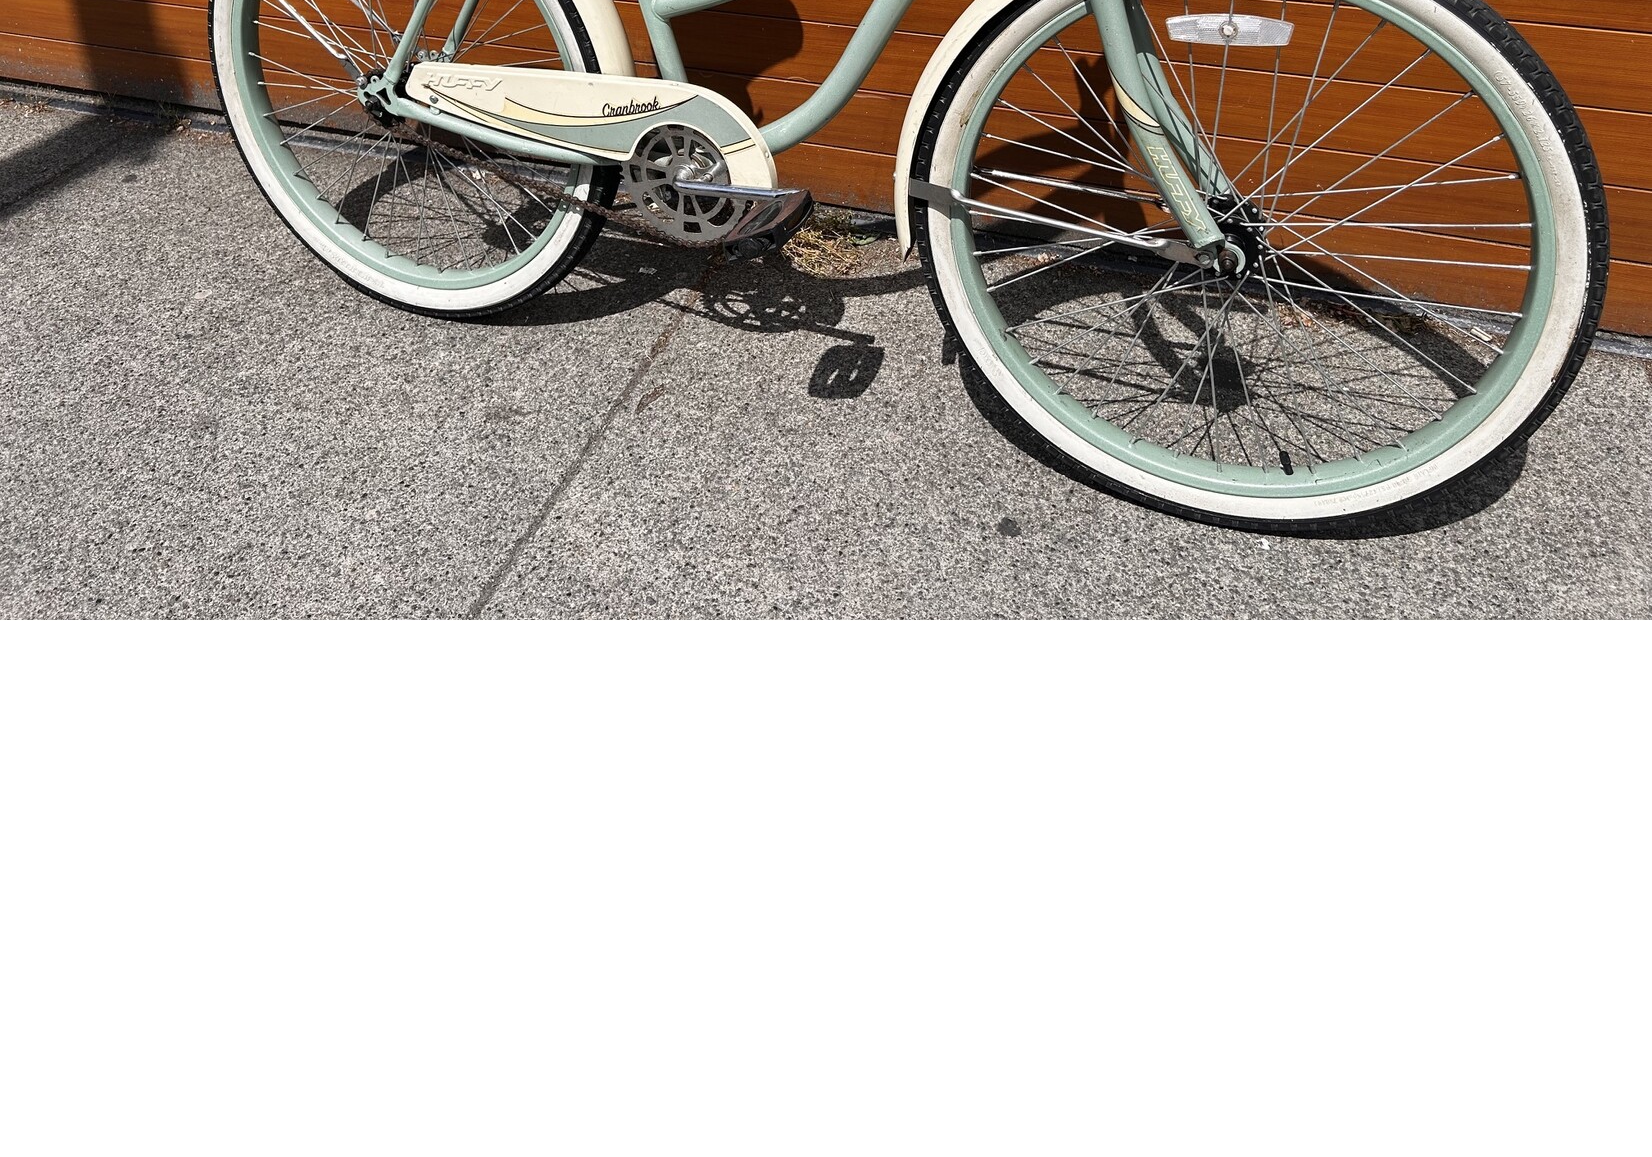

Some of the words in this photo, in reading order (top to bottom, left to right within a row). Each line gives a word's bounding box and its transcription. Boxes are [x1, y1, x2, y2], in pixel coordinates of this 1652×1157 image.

[423, 72, 503, 92] HUFFY
[602, 96, 660, 117] Cranbrook
[1147, 146, 1208, 235] HUFFY
